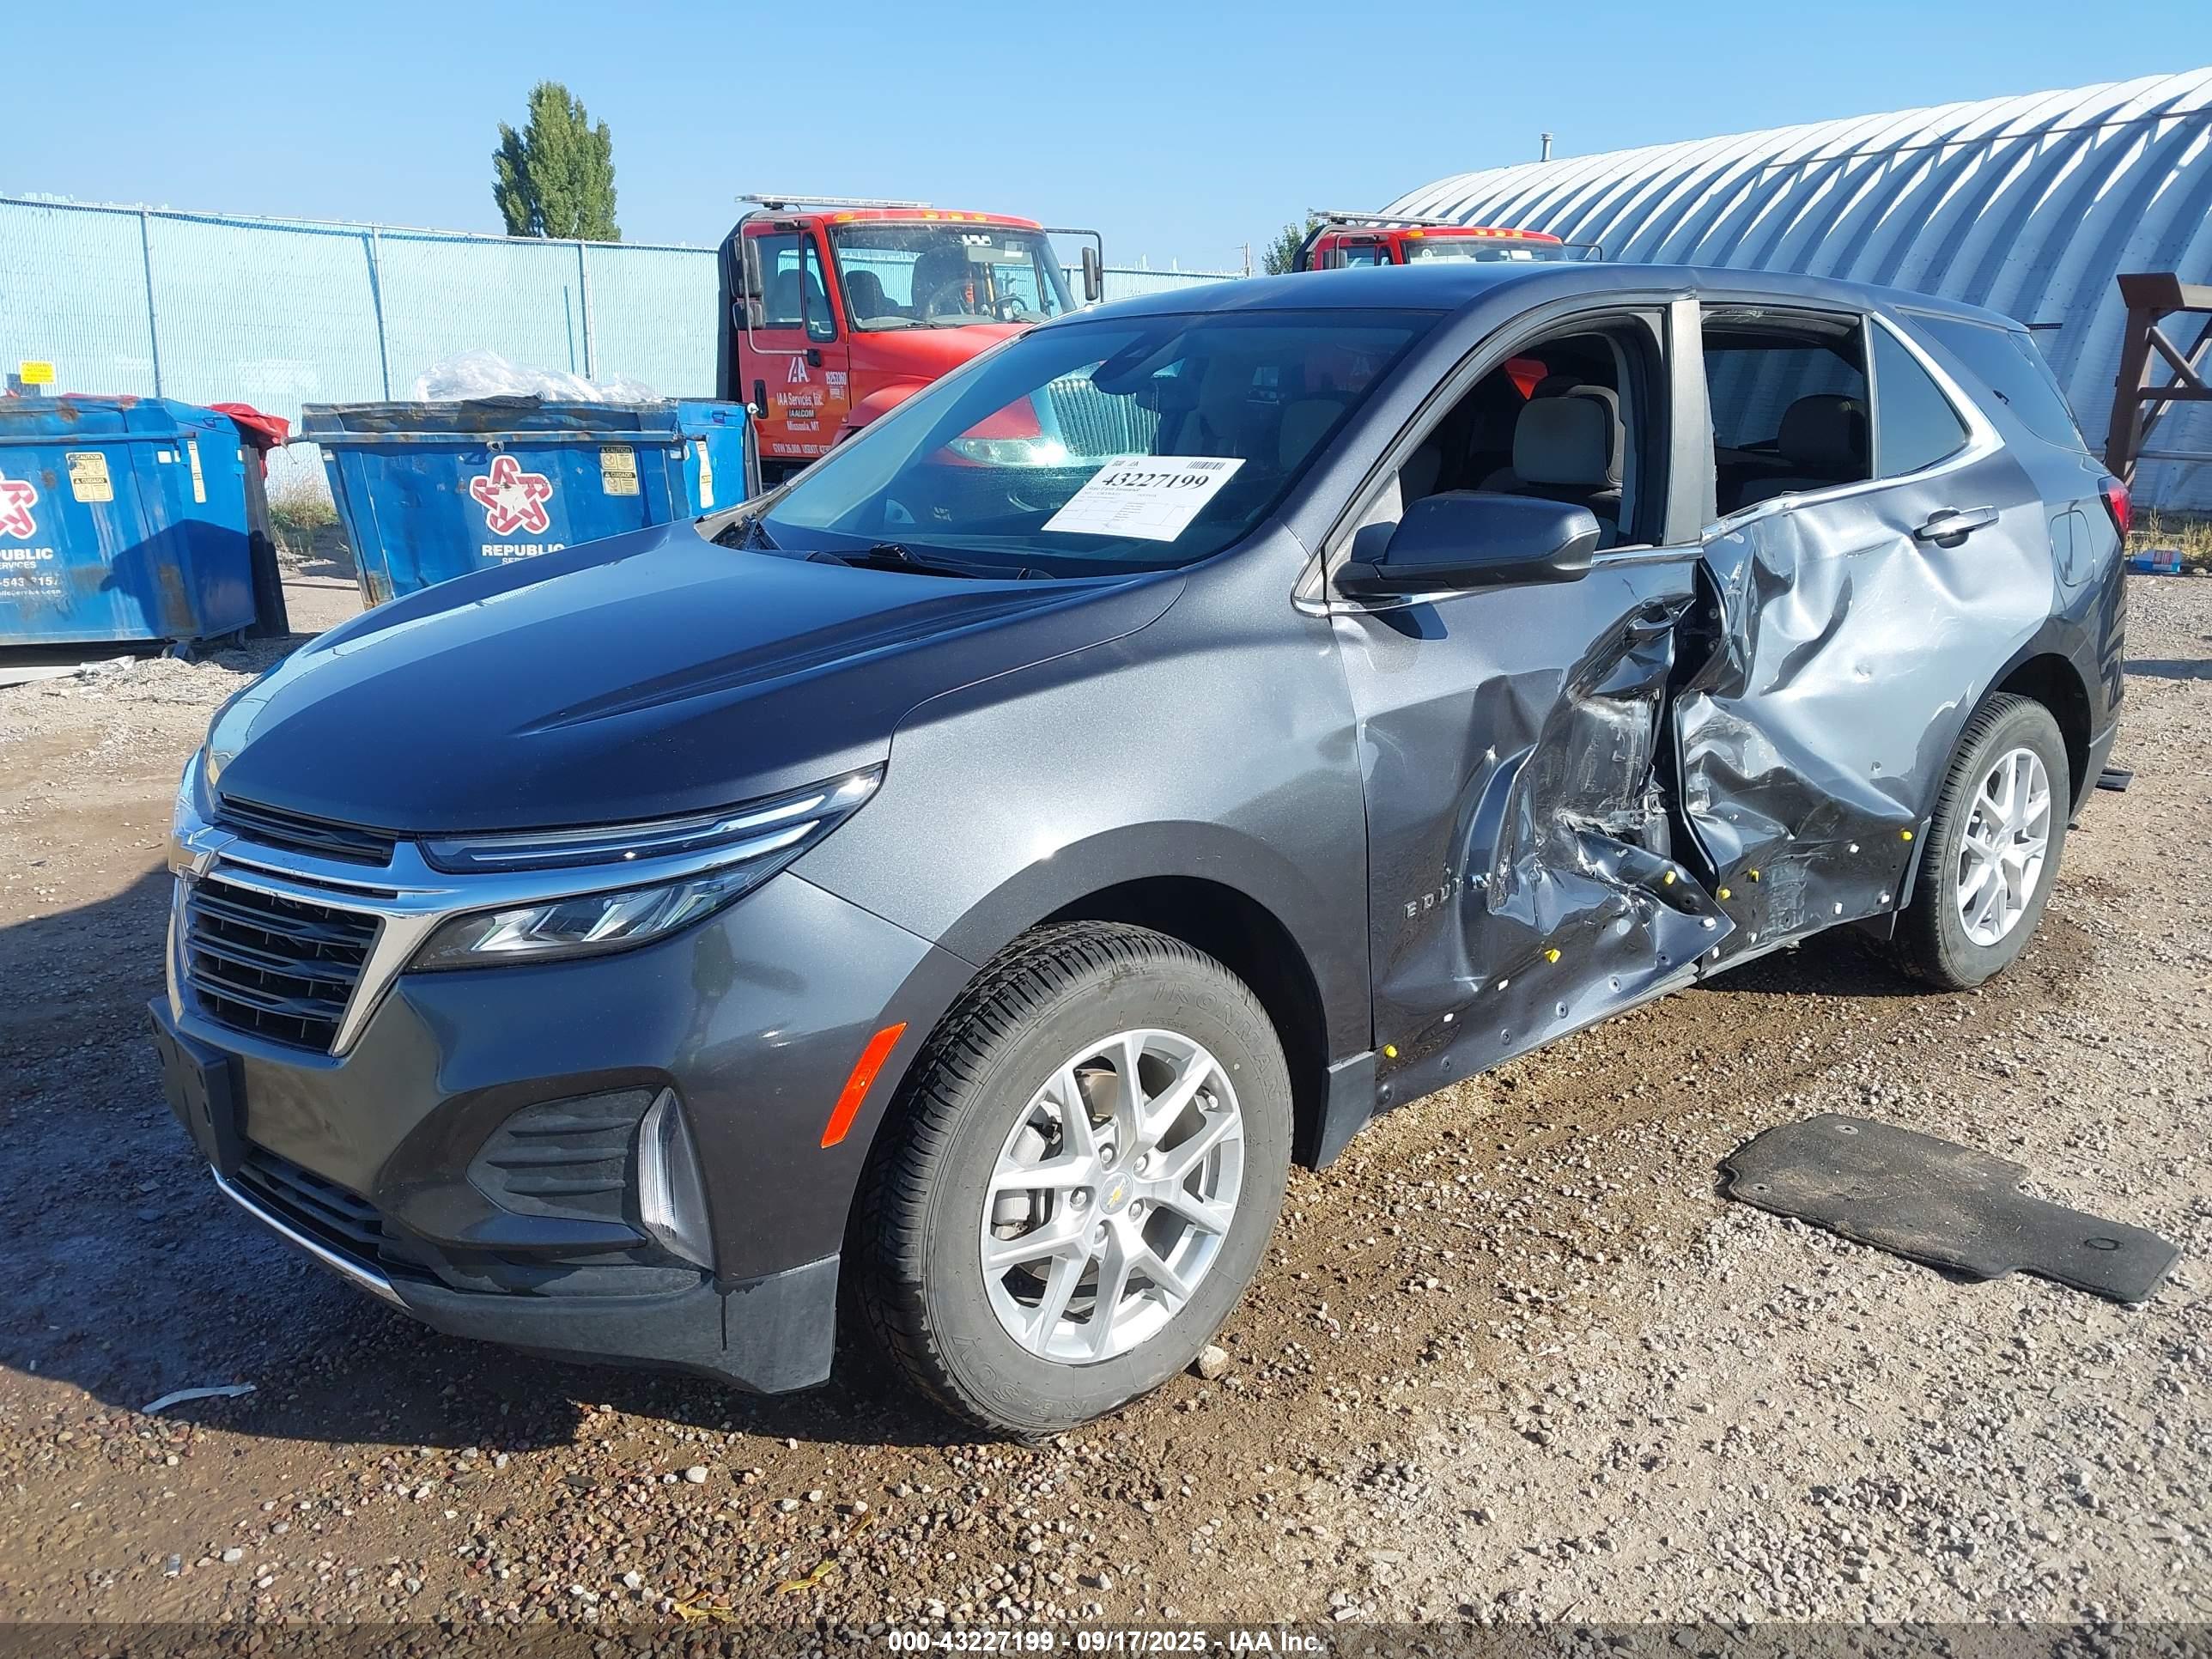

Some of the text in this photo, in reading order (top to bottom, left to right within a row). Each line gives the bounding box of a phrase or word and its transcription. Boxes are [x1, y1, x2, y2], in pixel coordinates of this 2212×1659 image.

[777, 392, 787, 405] IAA
[1102, 473, 1209, 489] 43227199
[0, 548, 53, 561] UBLIC
